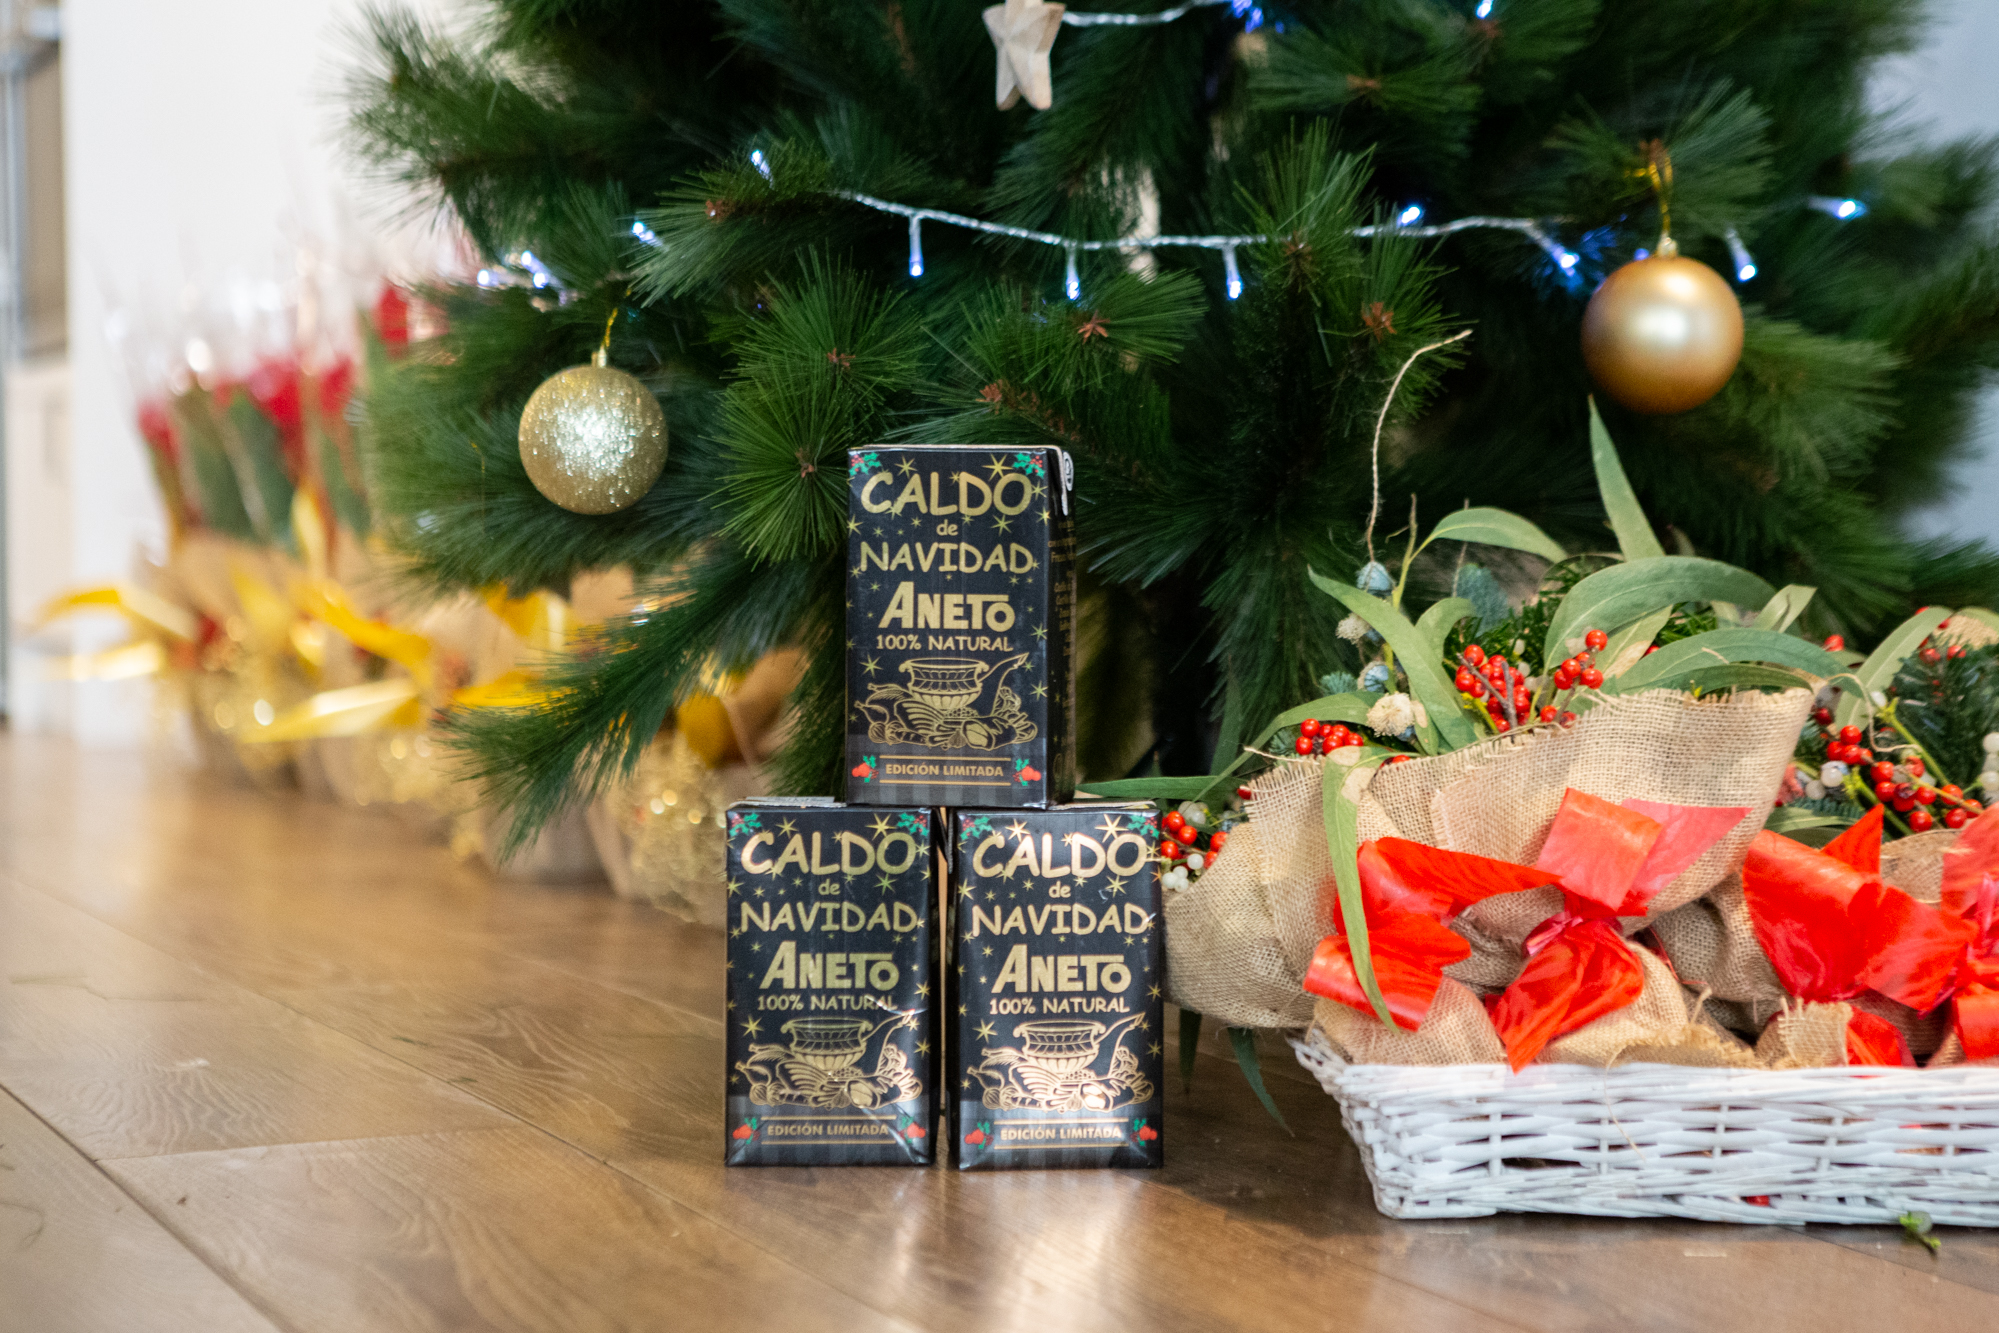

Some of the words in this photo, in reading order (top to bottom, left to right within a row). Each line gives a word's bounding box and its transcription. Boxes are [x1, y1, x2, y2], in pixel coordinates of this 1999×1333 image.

[860, 471, 1033, 517] CALDO
[937, 519, 958, 536] de
[860, 542, 1034, 574] NAVIDAD
[876, 635, 921, 650] 100%
[928, 635, 1013, 652] NATURAL
[885, 762, 939, 776] EDICIÓN
[943, 764, 1004, 777] LIMITADA
[741, 831, 916, 875] CALDO
[972, 833, 1149, 879] CALDO
[818, 879, 840, 896] de
[1049, 881, 1071, 899] de
[740, 902, 918, 933] NAVIDAD
[972, 903, 1150, 937] NAVIDAD
[757, 995, 804, 1011] 100%
[810, 995, 897, 1011] NATURAL
[990, 998, 1036, 1014] 100%
[1043, 997, 1130, 1014] NATURAL
[767, 1122, 823, 1136] EDICIÓN
[827, 1124, 889, 1136] LIMITADA
[1000, 1125, 1056, 1140] EDICIÓN
[1060, 1127, 1122, 1139] LIMITADA
